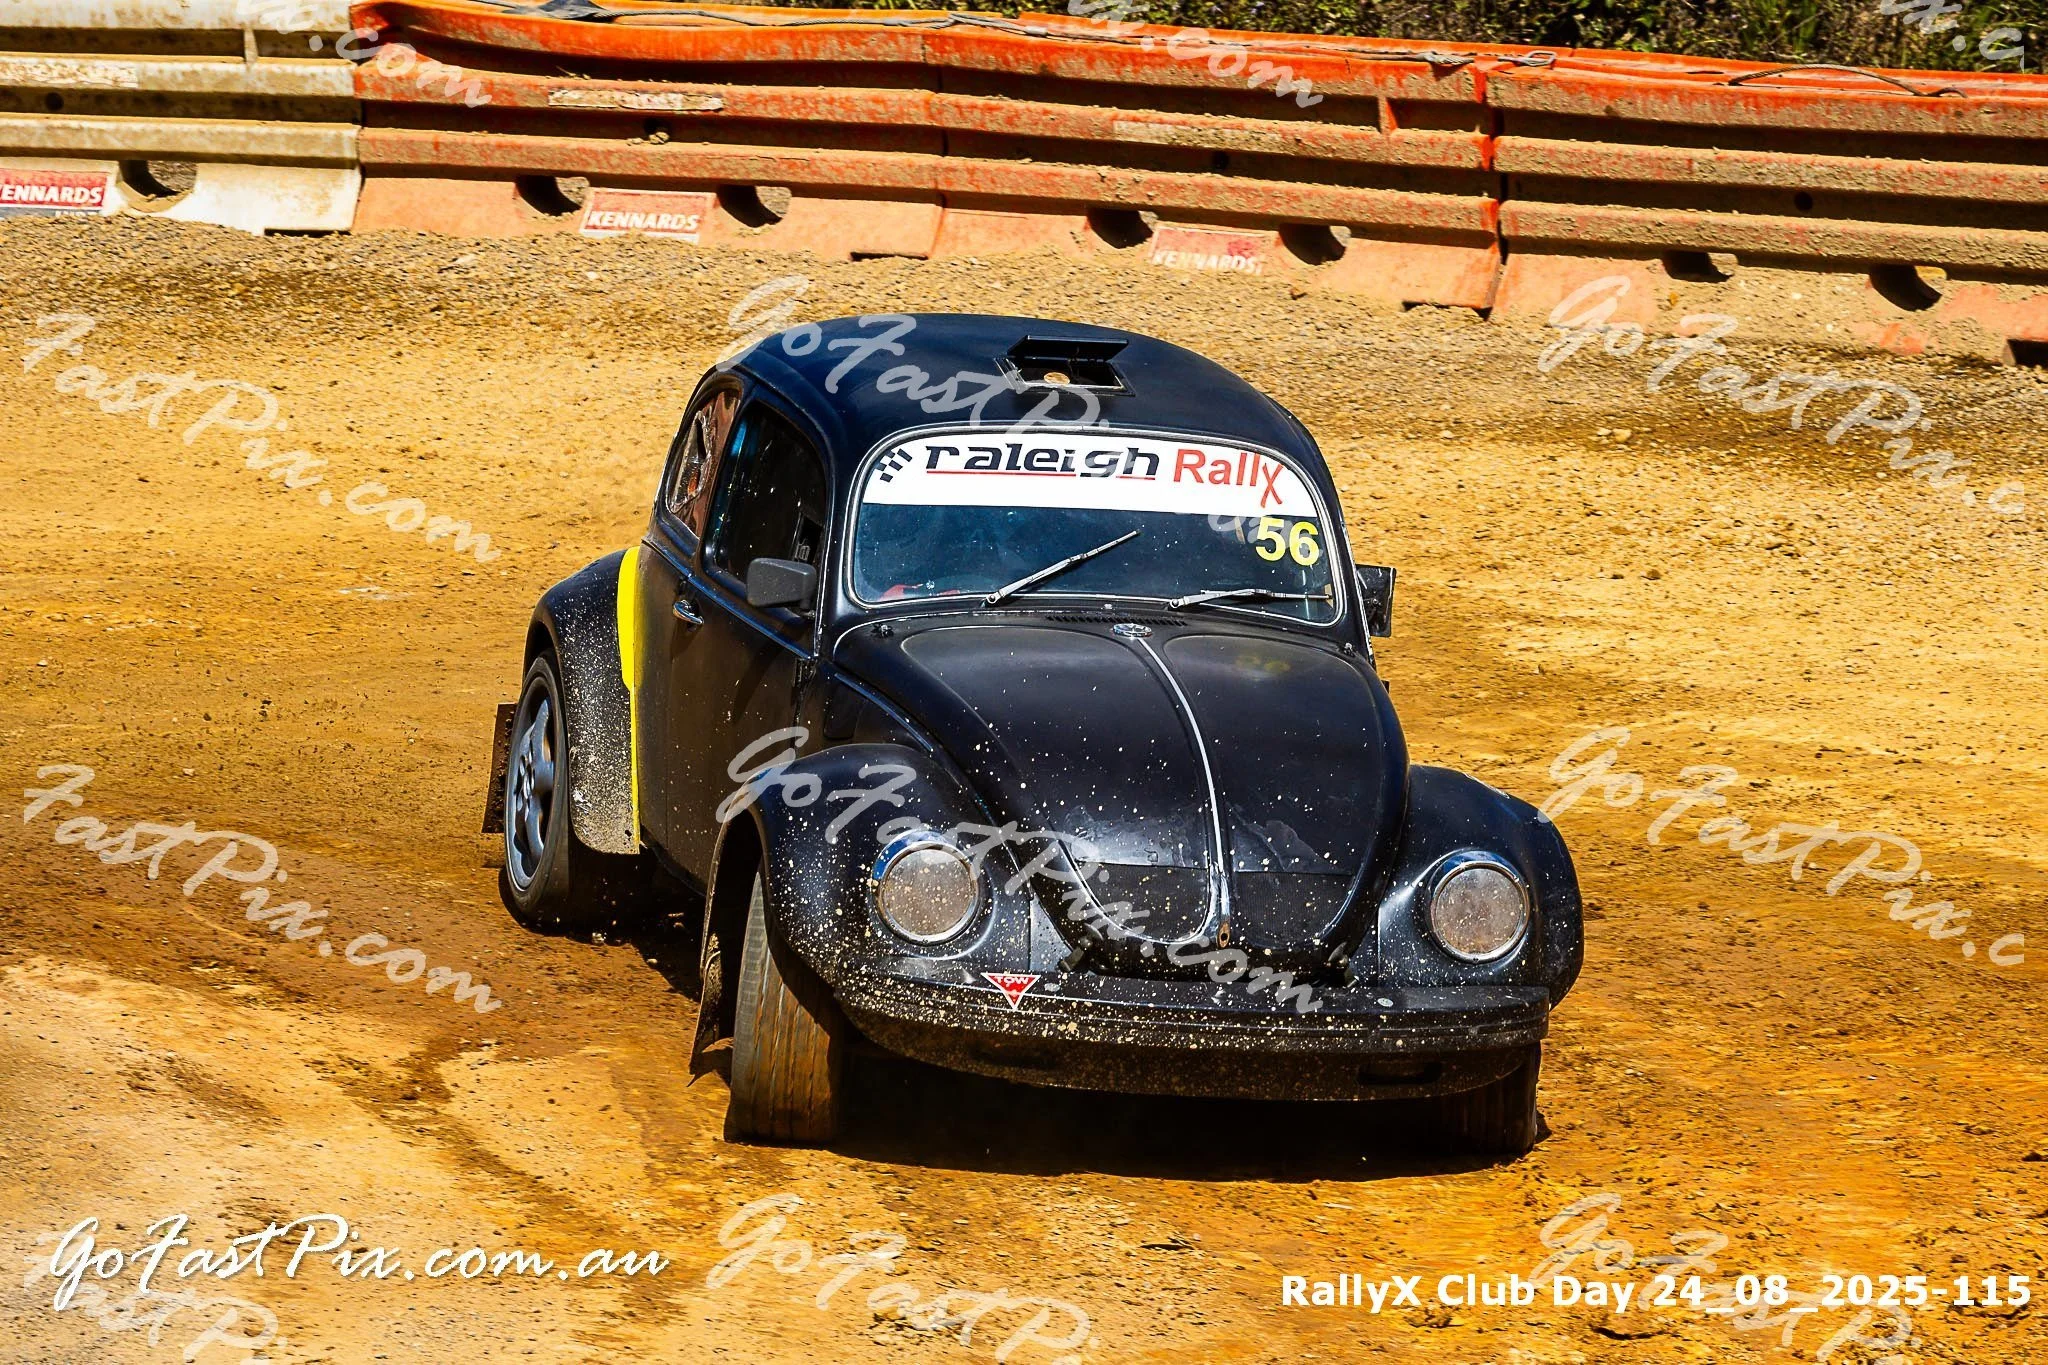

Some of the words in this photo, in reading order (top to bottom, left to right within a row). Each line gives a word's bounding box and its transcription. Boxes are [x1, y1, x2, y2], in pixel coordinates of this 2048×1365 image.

[0, 183, 103, 204] ENNARDS
[587, 210, 699, 230] KENNARDS
[925, 443, 1160, 478] raleigh
[1255, 516, 1320, 566] 56
[994, 975, 1029, 986] TOW
